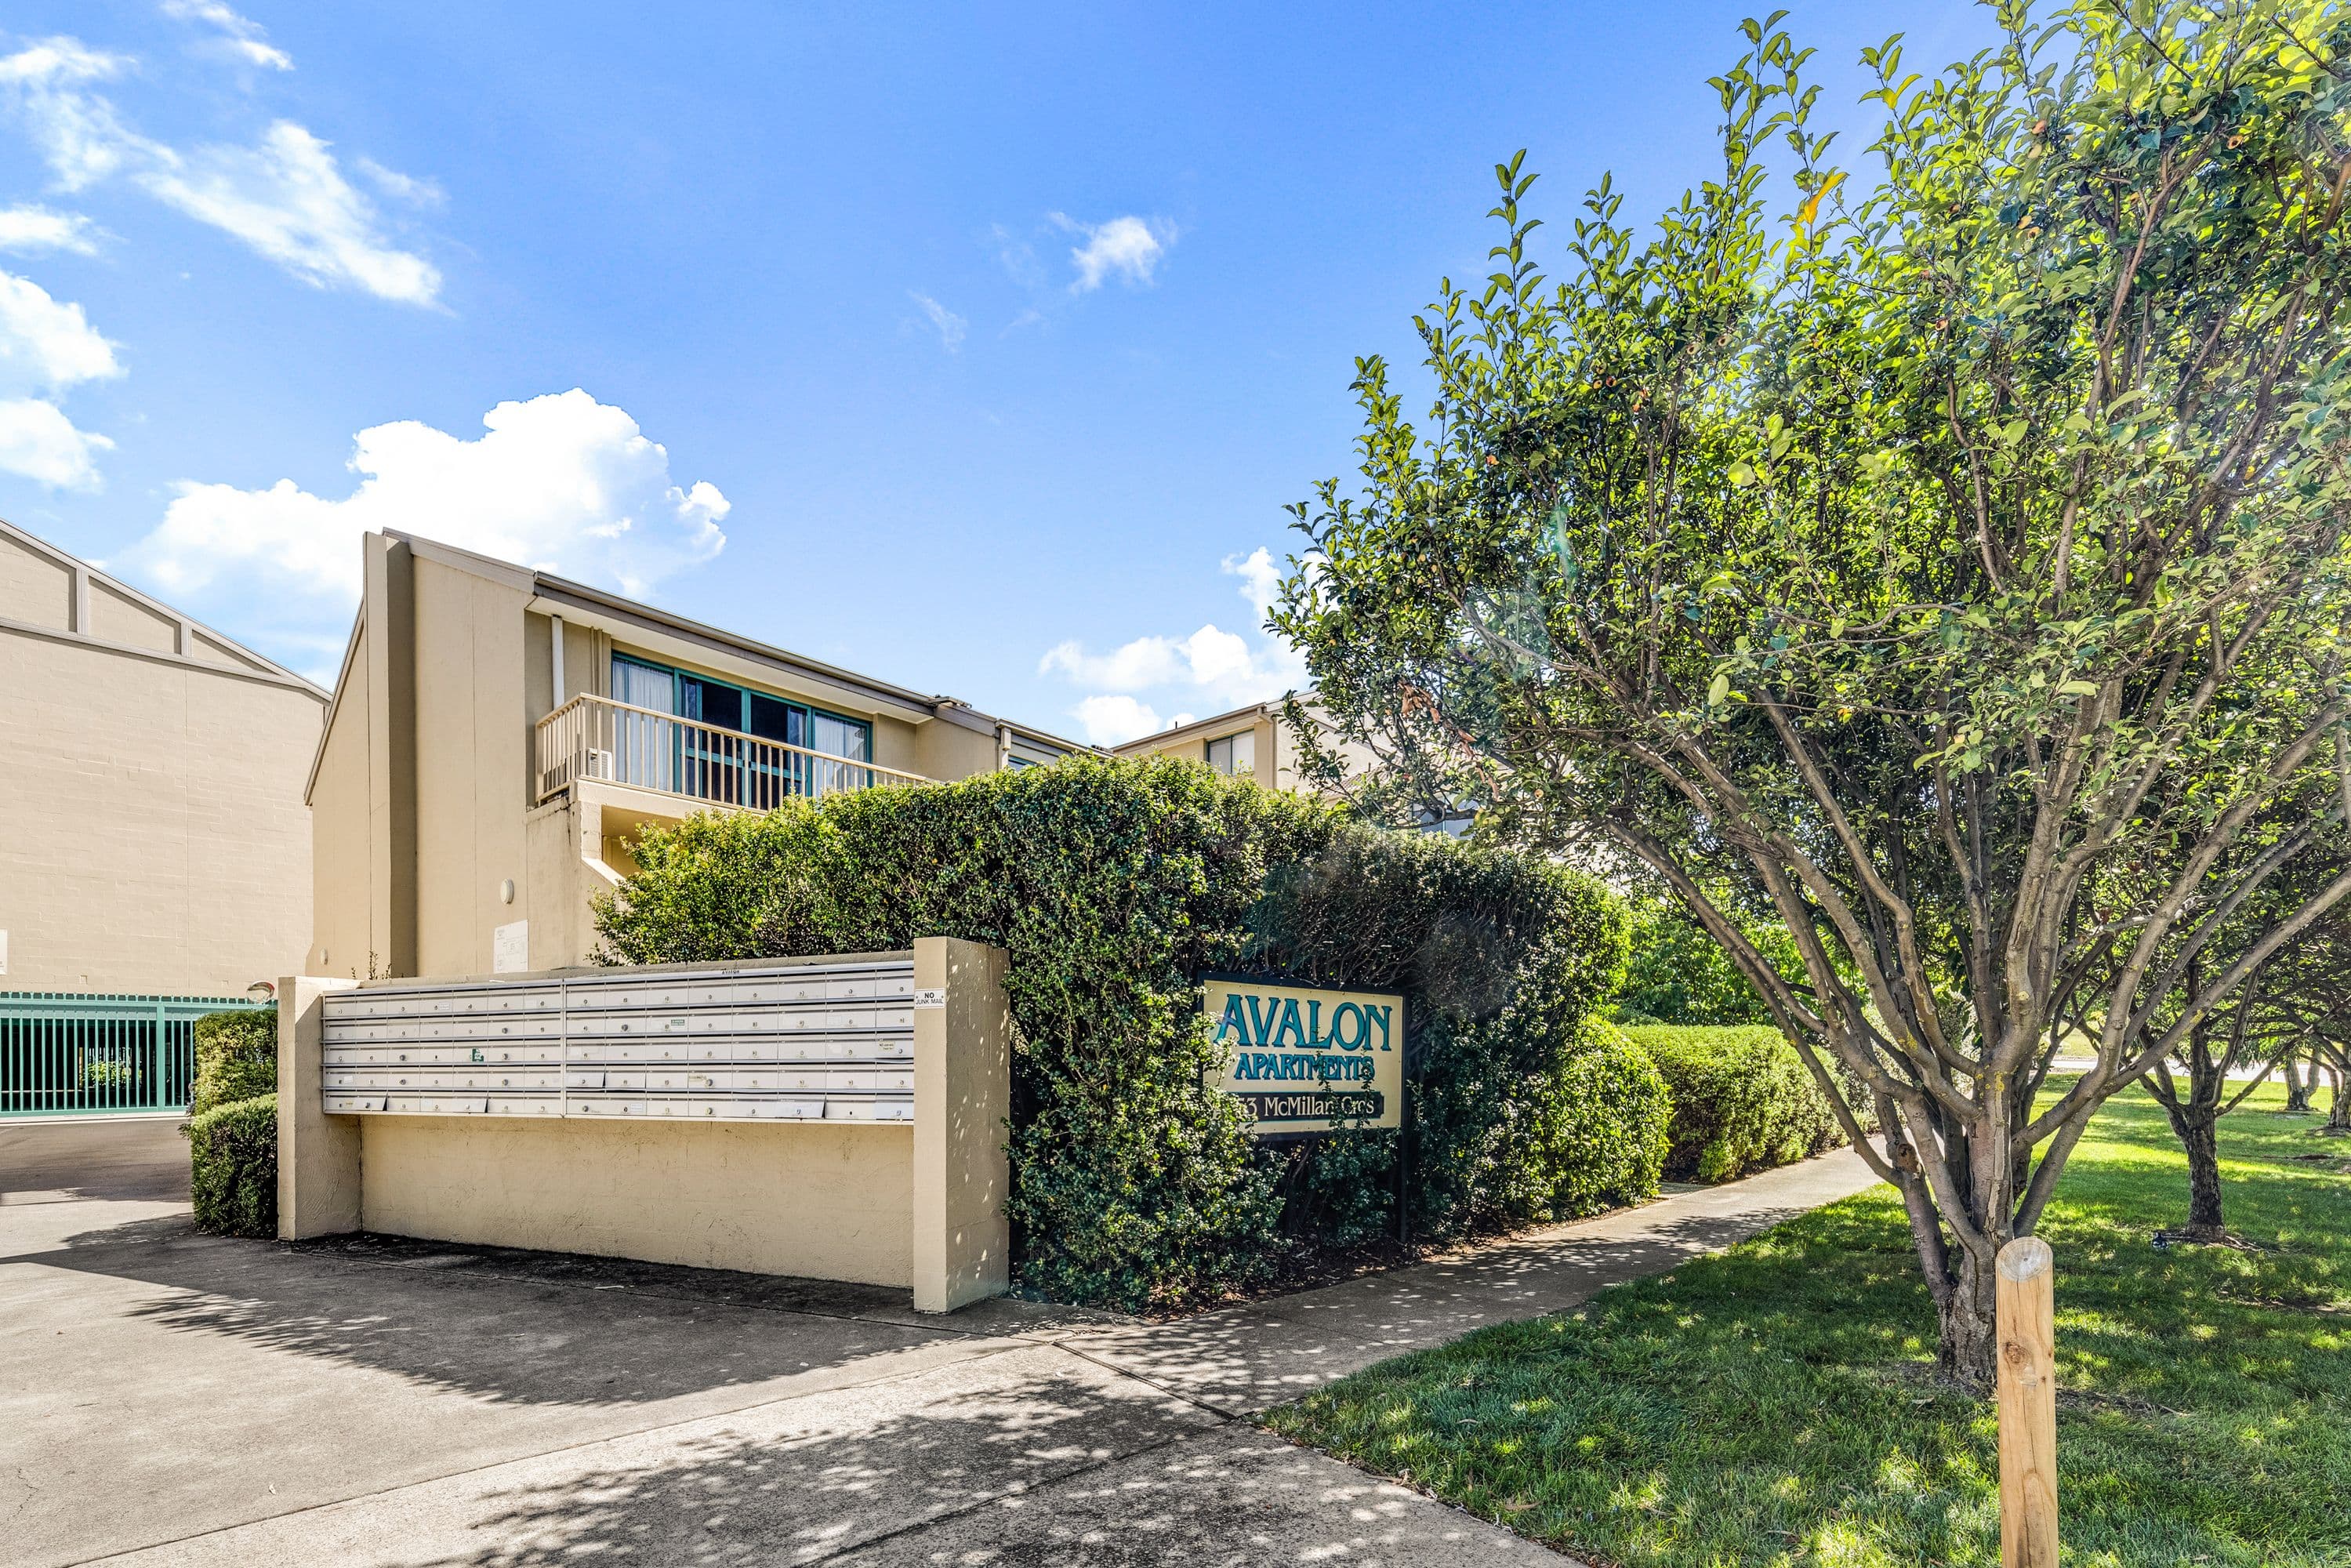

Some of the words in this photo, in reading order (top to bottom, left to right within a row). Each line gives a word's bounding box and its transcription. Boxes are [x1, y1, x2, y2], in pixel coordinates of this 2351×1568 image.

[1213, 993, 1392, 1051] AVALON
[1234, 1053, 1376, 1081] APARTMENTS
[1264, 1095, 1334, 1117] McMillan
